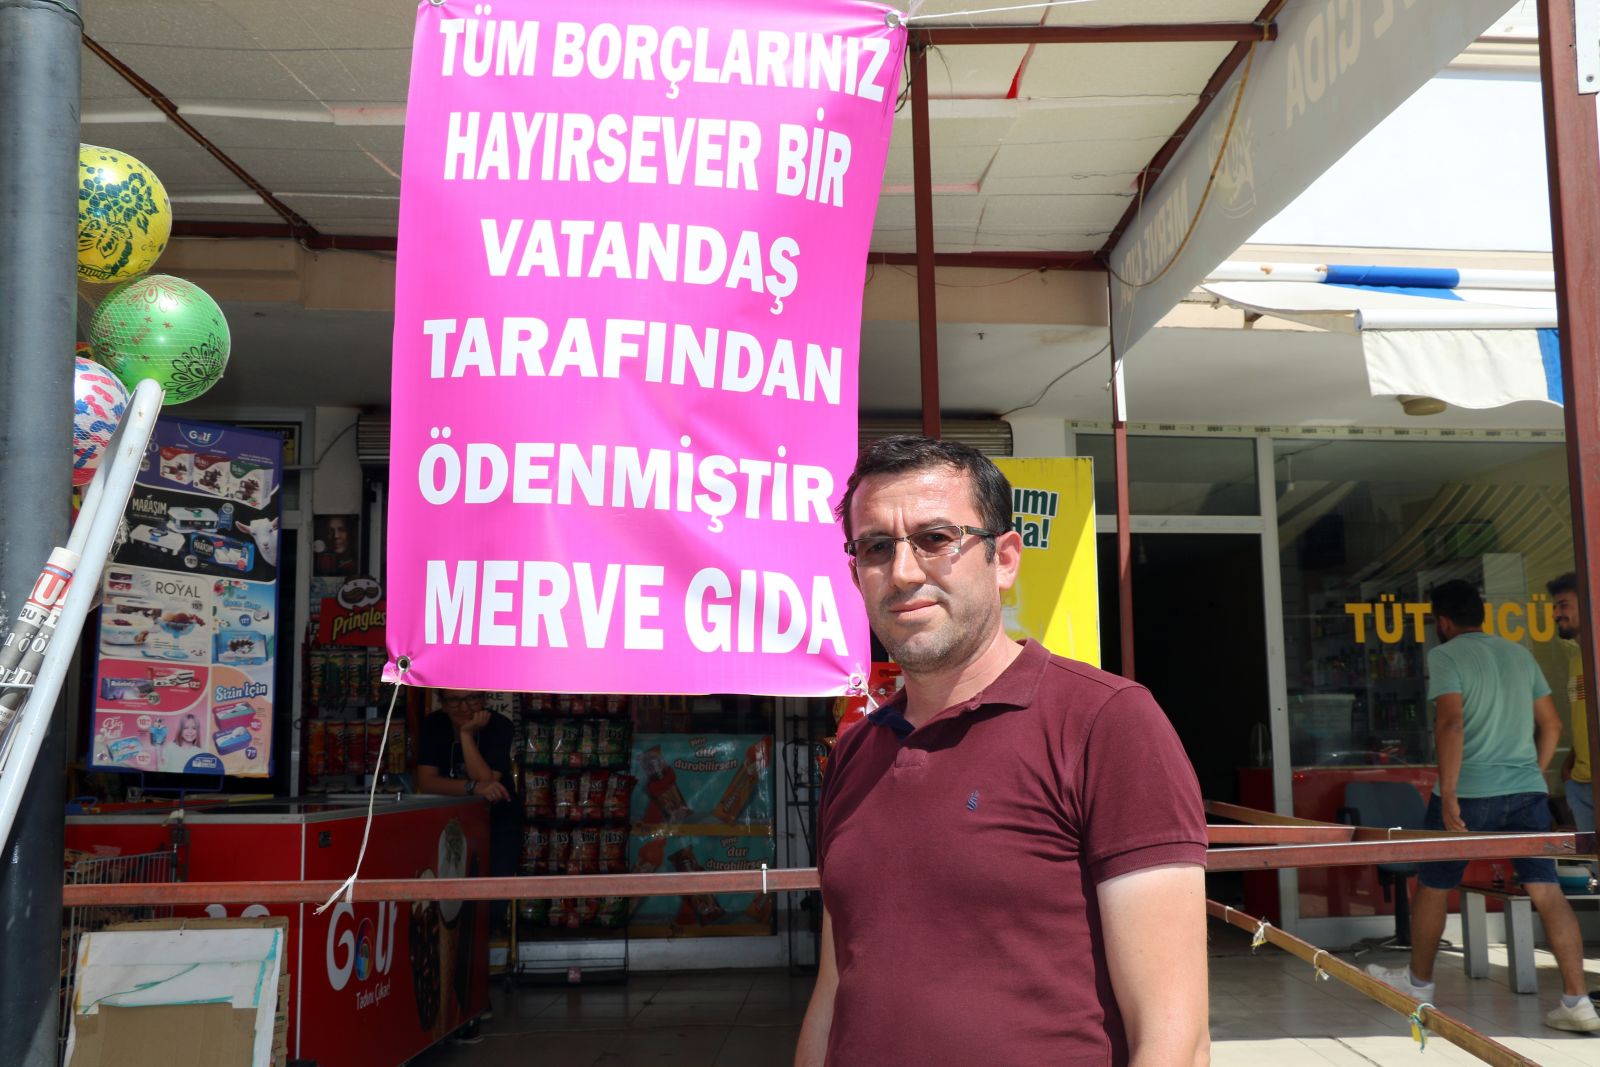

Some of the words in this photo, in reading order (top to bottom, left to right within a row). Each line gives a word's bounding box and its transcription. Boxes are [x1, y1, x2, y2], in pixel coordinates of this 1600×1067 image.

[439, 5, 540, 77] TÜM
[552, 22, 891, 102] BORÇLARINIZ
[443, 111, 761, 191] HAYIRSEVER
[776, 107, 851, 207] BİR
[480, 218, 801, 315] VATANDAŞ
[423, 317, 843, 405] TARAFINDAN
[132, 498, 168, 516] MARAŞIM
[418, 426, 836, 533] ÖDENMİŞTİR
[1013, 488, 1058, 517] ımı
[155, 581, 200, 598] ROYAL
[425, 560, 664, 651] MERVE
[684, 567, 849, 656] GIDA
[1344, 594, 1555, 643] TÜTCÜ
[332, 607, 386, 641] Pringles
[215, 686, 242, 702] Sizin
